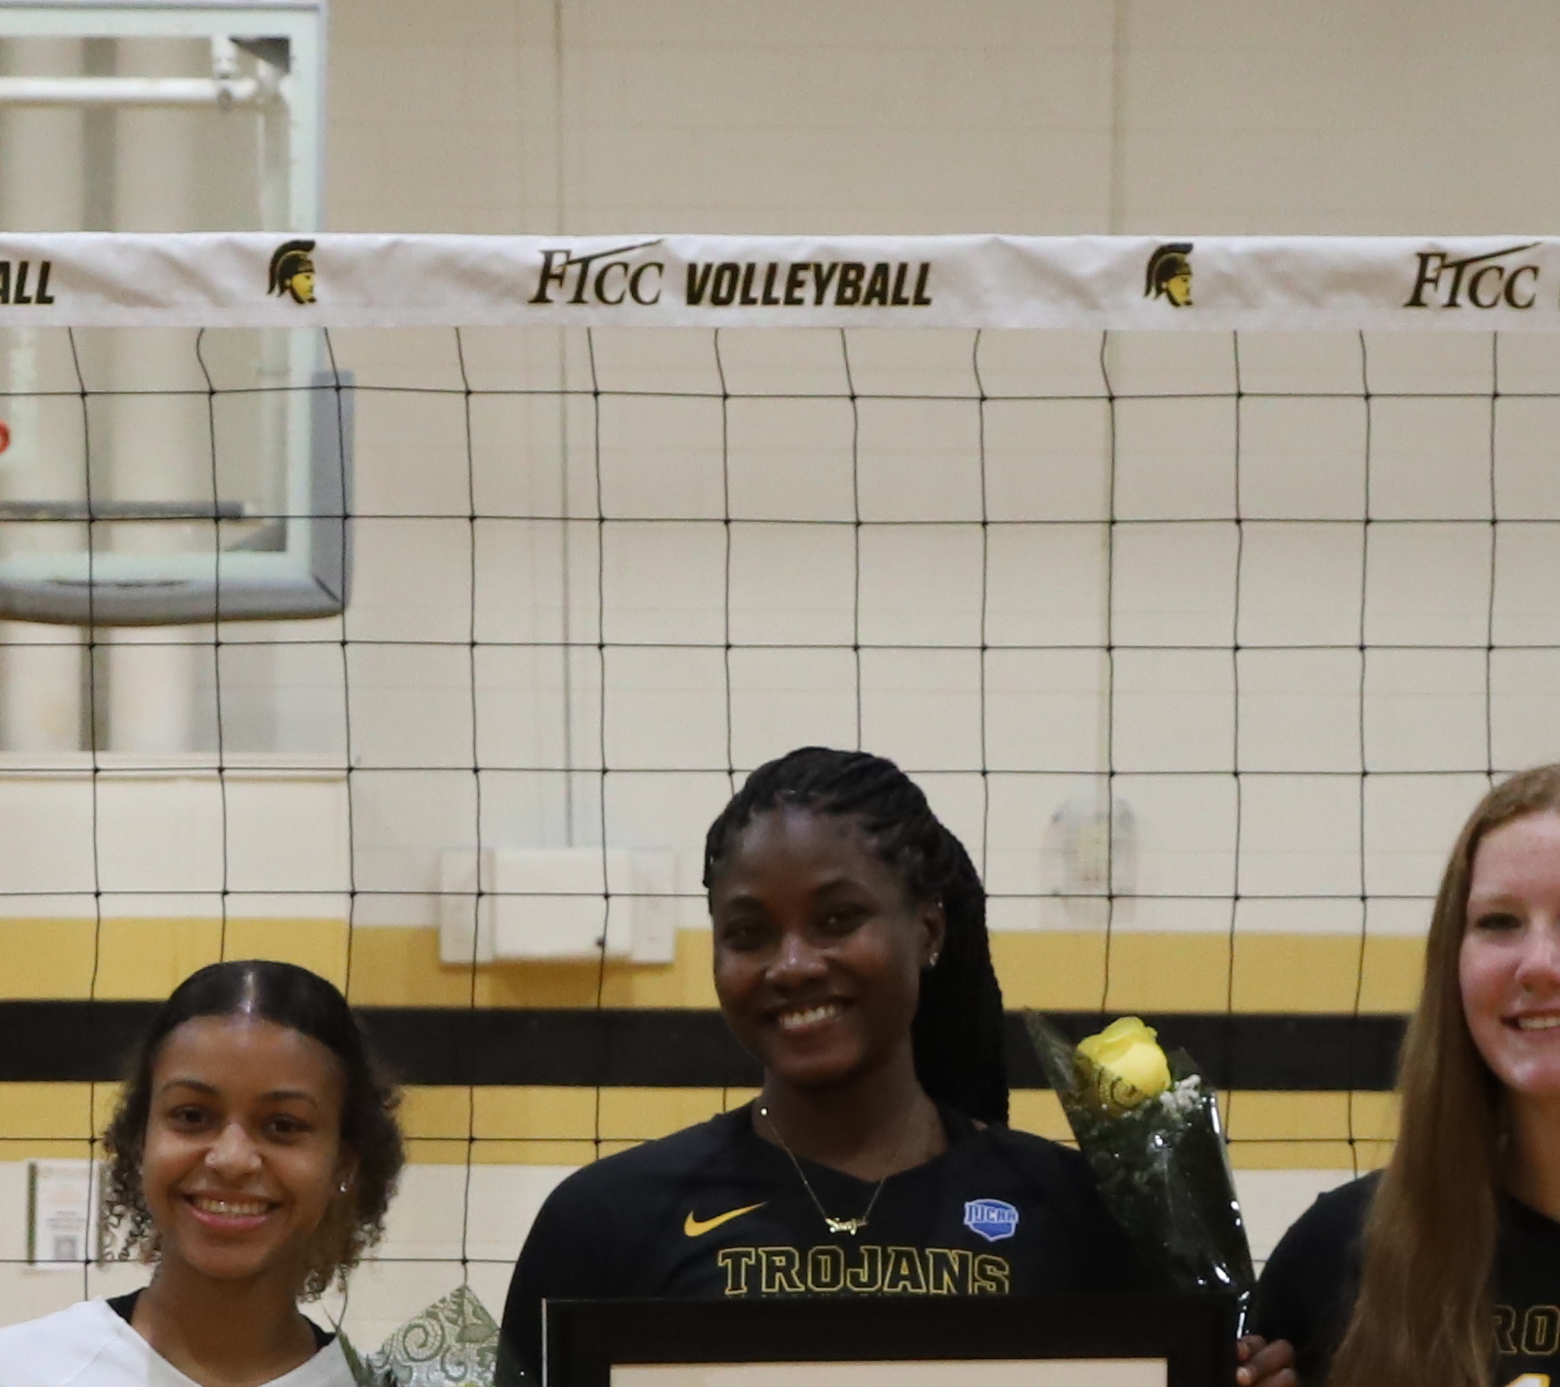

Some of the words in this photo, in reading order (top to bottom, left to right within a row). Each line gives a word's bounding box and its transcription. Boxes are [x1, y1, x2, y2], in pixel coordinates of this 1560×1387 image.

[527, 243, 664, 306] FTCC
[687, 262, 932, 307] VOLLEYBALL
[1403, 246, 1539, 310] FTCC
[718, 1245, 1010, 1295] TROJANS
